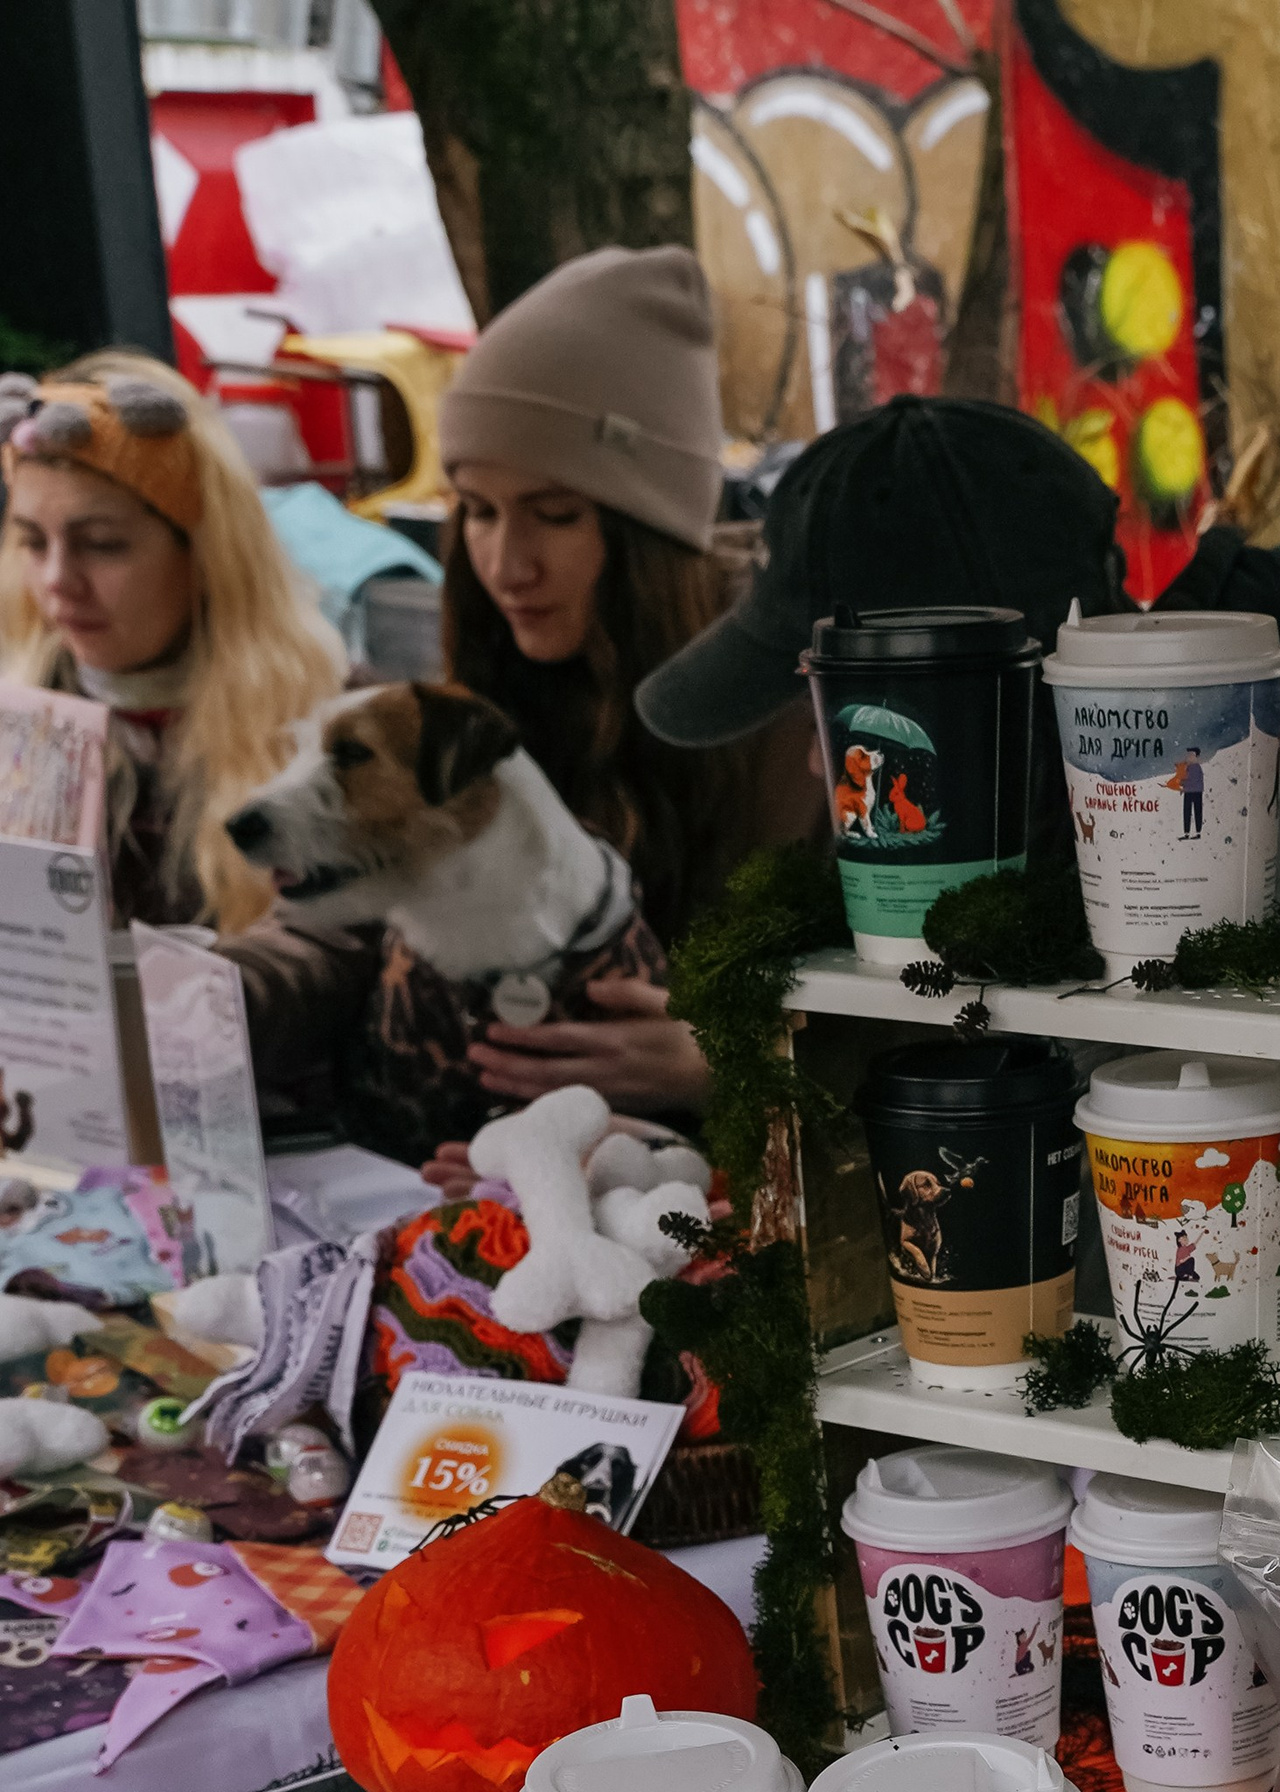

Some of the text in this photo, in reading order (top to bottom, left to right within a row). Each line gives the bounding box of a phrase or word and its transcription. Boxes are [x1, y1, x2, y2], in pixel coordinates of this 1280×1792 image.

[1074, 706, 1170, 730] ЛАКОМСТВО
[1079, 734, 1164, 761] ДЛЯ ДРУГА
[1095, 1147, 1173, 1178] ЛАКОМСТВО
[1098, 1172, 1169, 1203] ДЛЯ ДРУГА
[402, 1400, 505, 1424] ДЛЯ СОБАК
[411, 1379, 650, 1428] НЮХАТЕЛЬНЫЕ ИГРУШКИ
[410, 1455, 491, 1496] 15%
[884, 1572, 983, 1626] DOG'S
[1118, 1584, 1224, 1638] DOG'S
